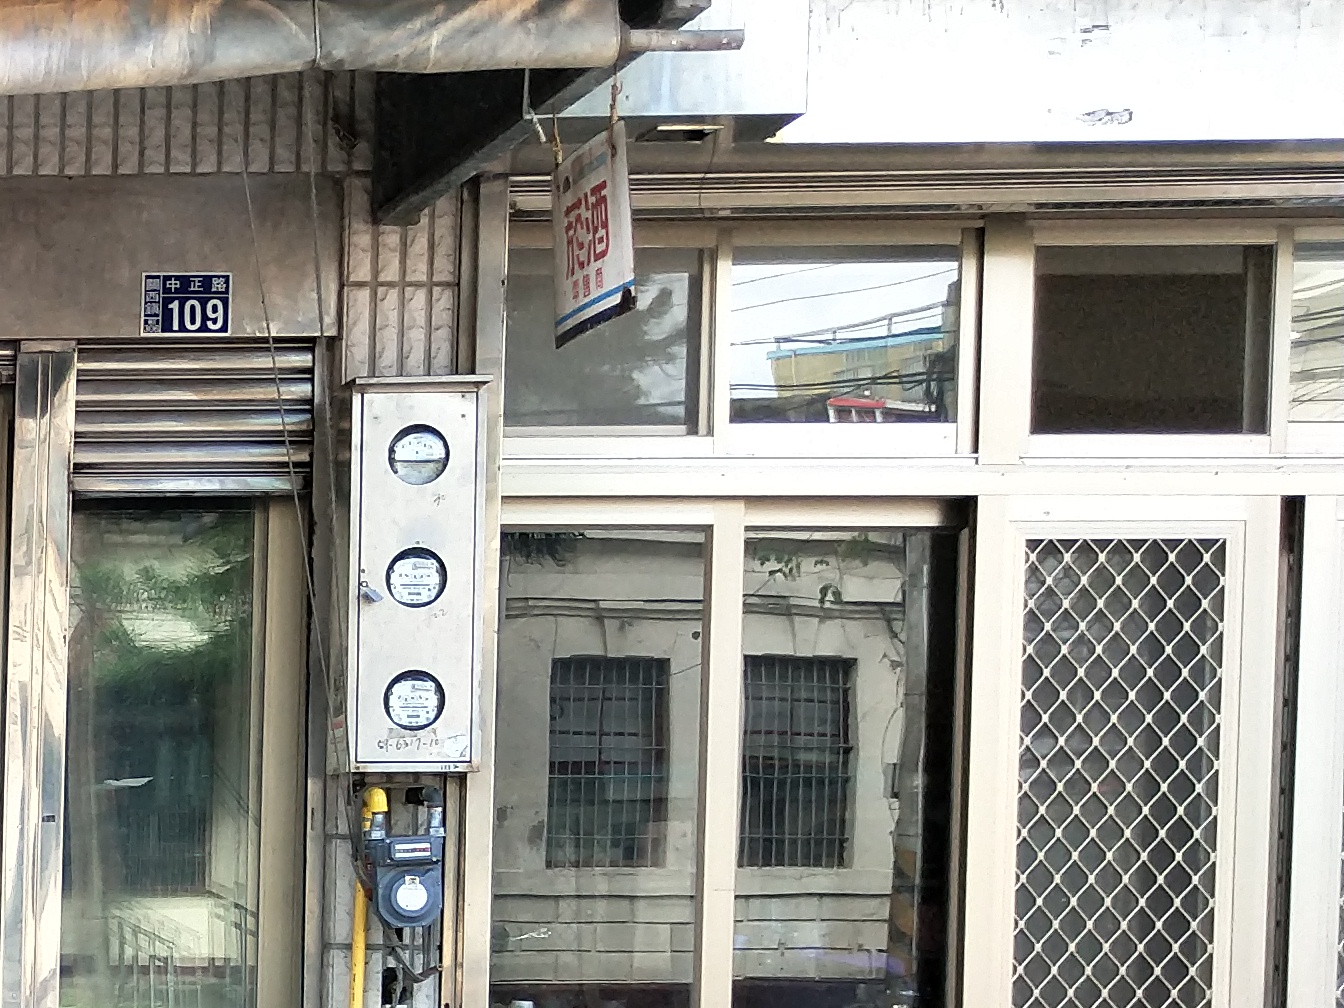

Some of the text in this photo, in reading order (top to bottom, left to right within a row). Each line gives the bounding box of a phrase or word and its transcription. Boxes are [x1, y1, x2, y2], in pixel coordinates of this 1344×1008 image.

[165, 277, 227, 293] 中正路
[167, 299, 224, 331] 109
